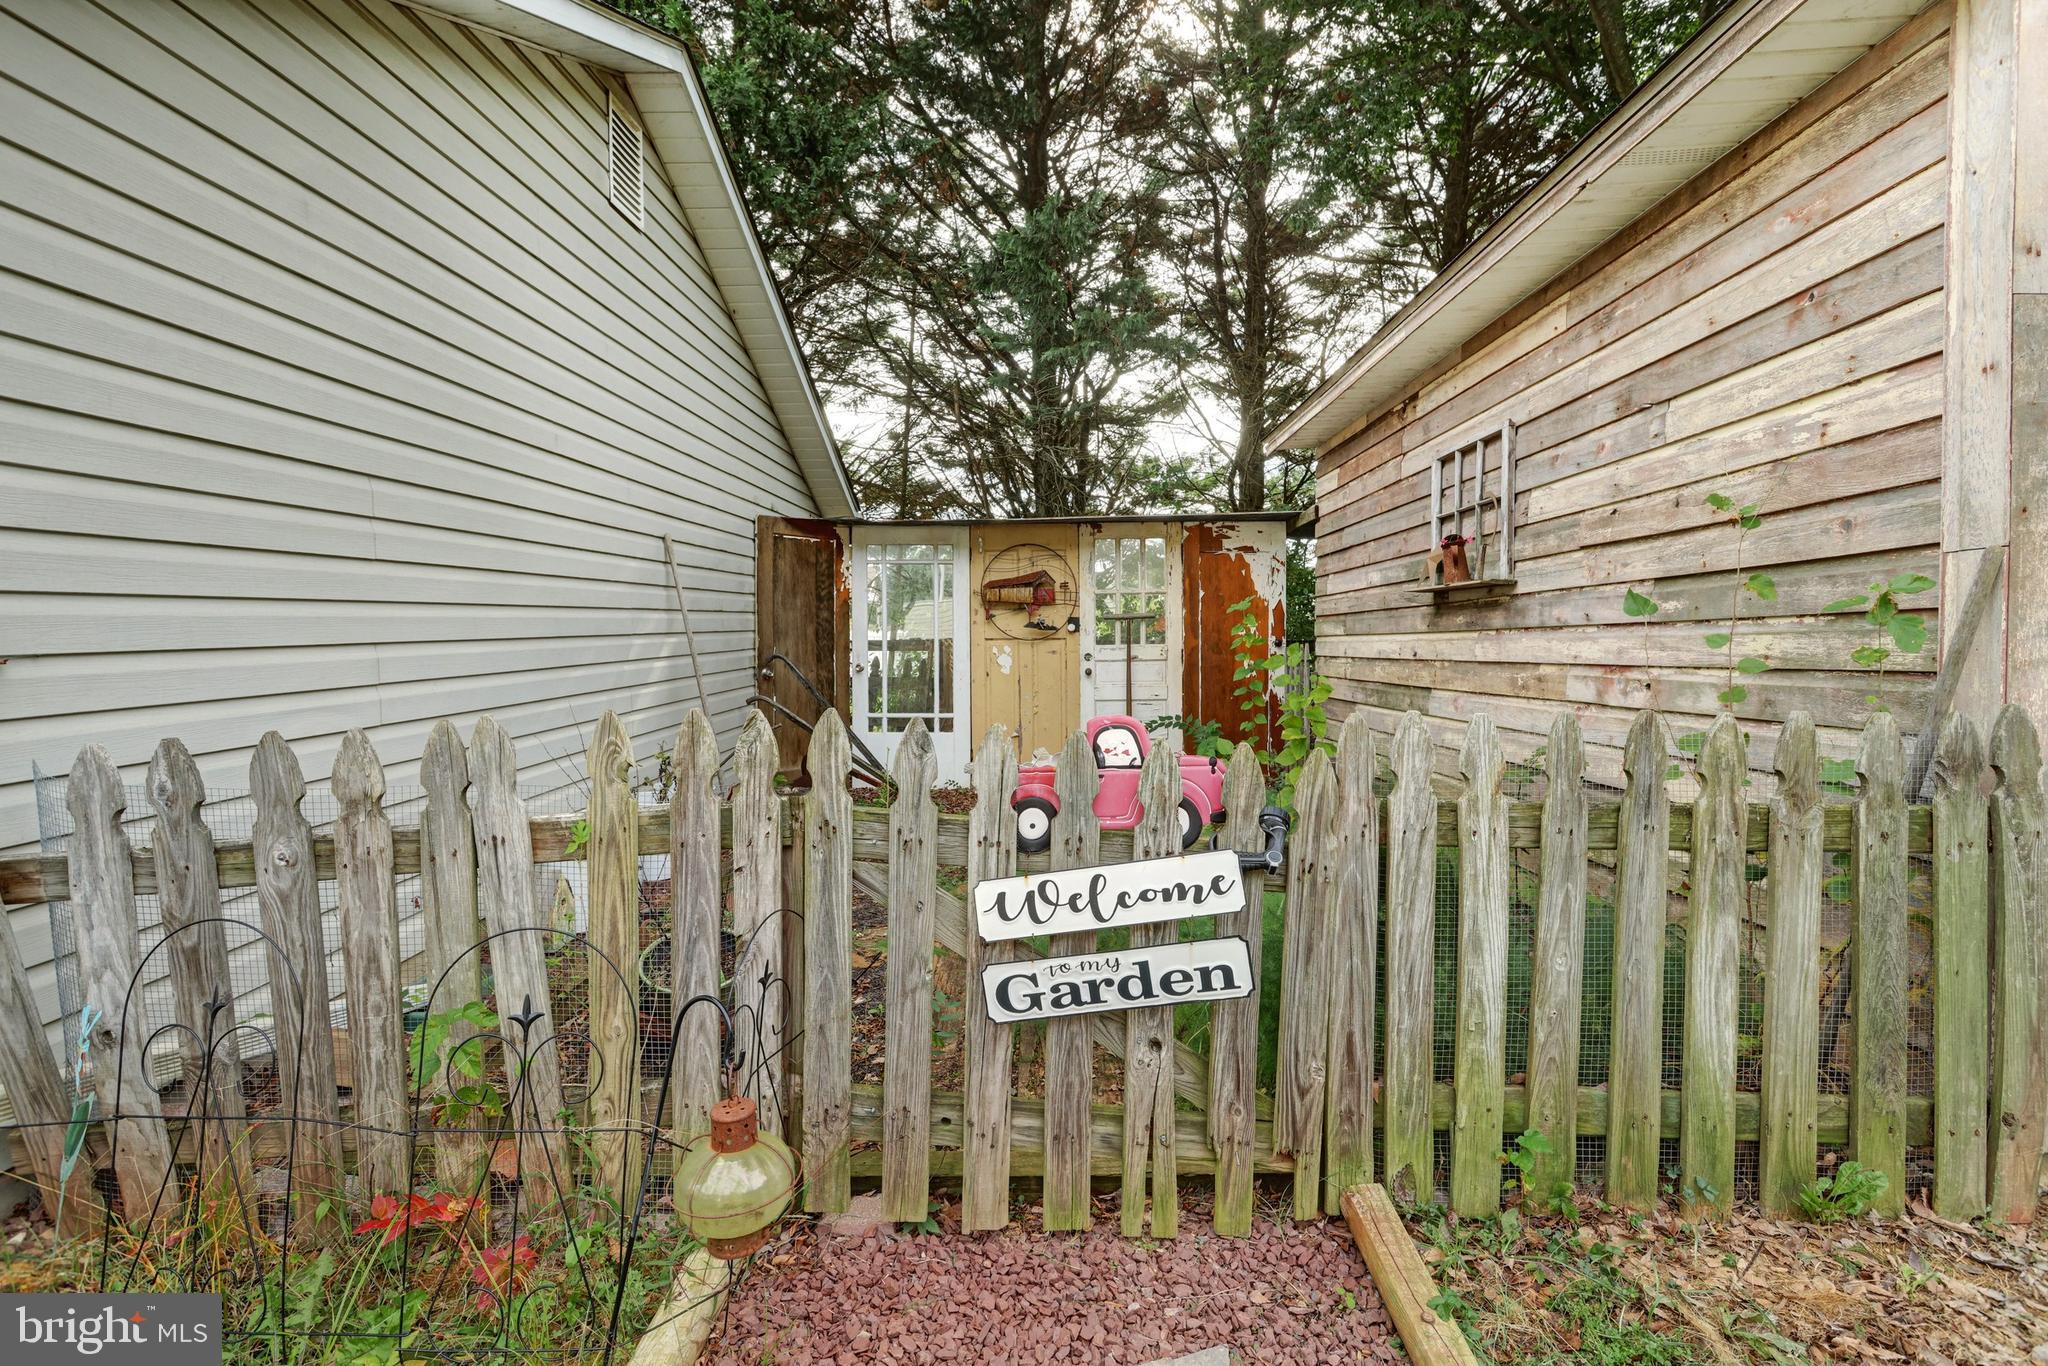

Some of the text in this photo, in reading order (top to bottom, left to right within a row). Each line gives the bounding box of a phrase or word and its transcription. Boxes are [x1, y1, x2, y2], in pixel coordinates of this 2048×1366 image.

[983, 873, 1236, 925] Welcome
[995, 960, 1242, 1014] Garden
[1042, 956, 1122, 978] to my
